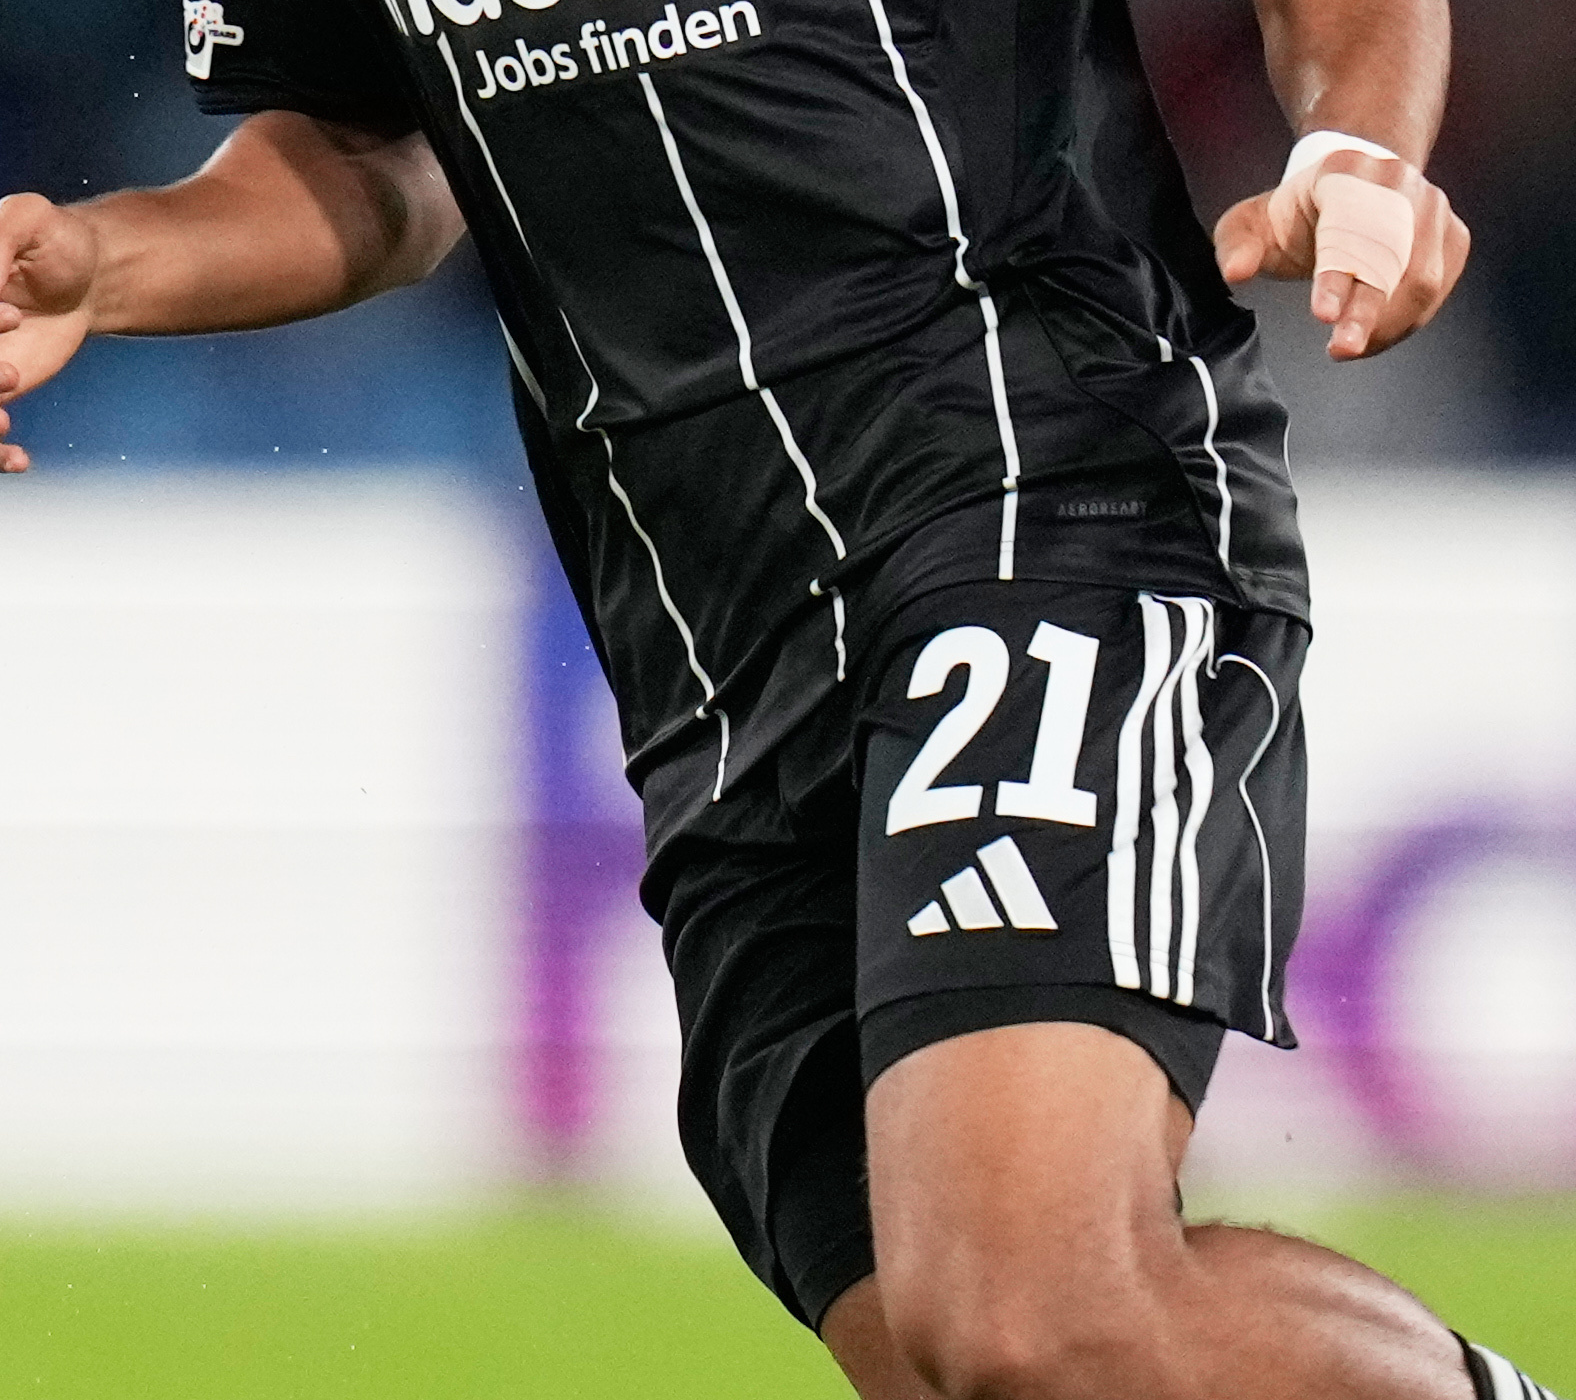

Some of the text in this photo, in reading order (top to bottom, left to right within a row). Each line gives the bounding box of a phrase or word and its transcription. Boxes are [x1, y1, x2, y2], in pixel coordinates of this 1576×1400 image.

[475, 0, 762, 100] Jobs finden
[885, 620, 1101, 837] 21
